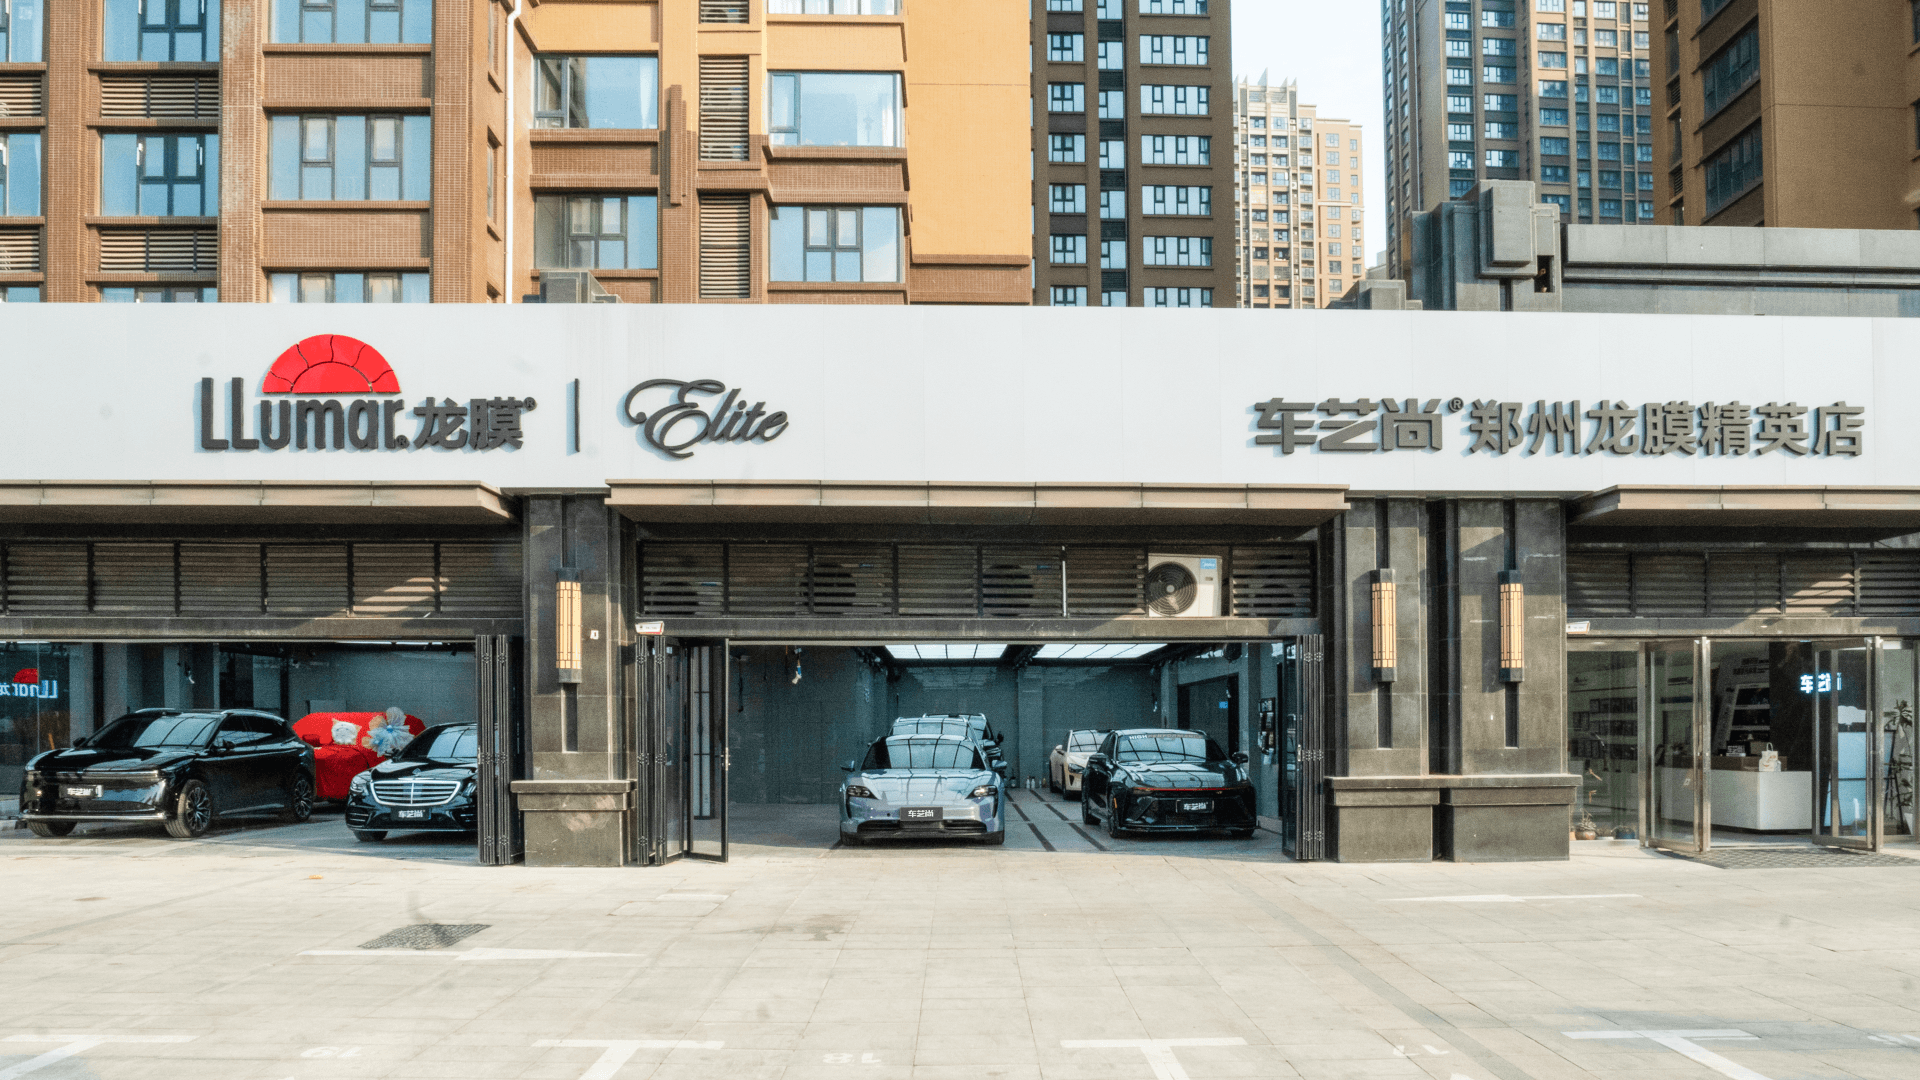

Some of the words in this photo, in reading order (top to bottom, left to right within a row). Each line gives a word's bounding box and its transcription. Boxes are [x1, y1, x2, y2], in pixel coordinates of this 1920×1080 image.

[625, 378, 788, 459] Elite
[908, 810, 933, 818] 车艺尚
